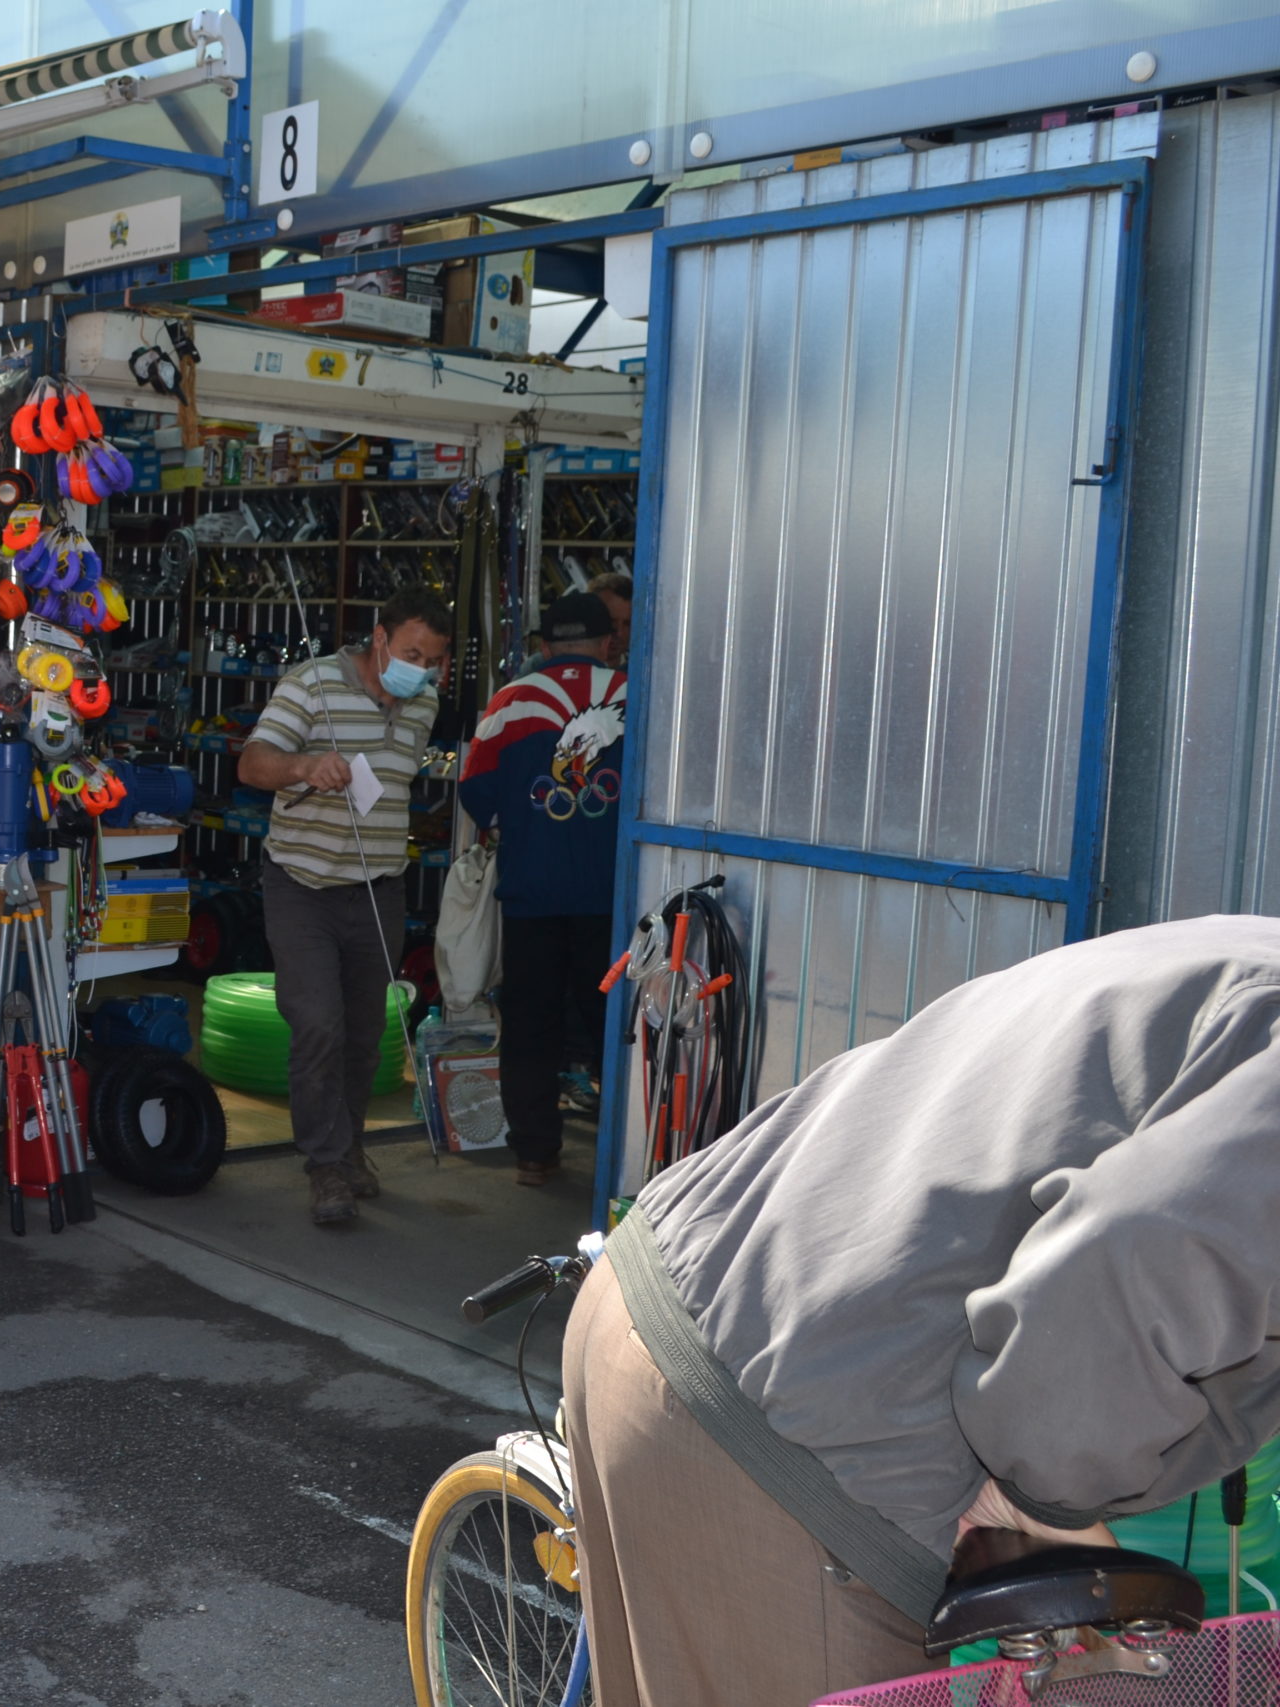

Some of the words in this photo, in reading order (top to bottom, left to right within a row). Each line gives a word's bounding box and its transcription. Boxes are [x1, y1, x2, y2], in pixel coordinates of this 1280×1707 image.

[280, 115, 298, 191] 8
[355, 348, 374, 386] 7
[503, 371, 529, 395] 28
